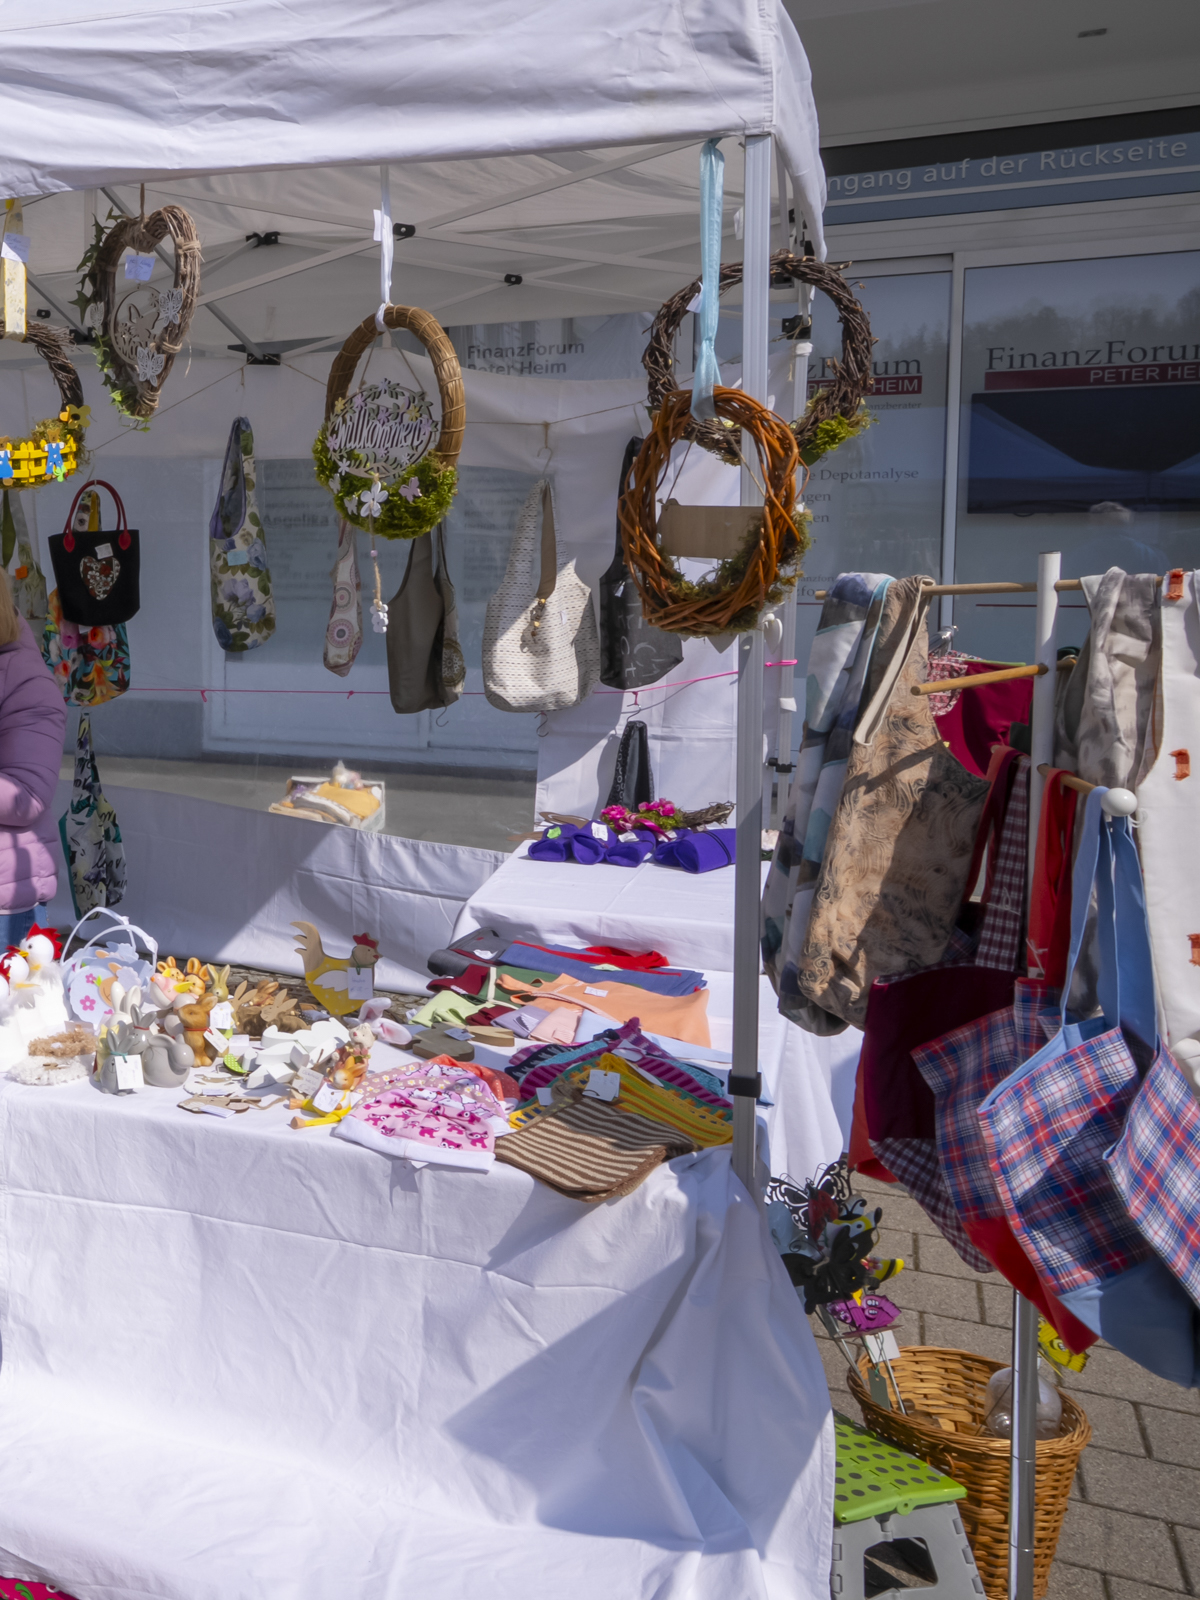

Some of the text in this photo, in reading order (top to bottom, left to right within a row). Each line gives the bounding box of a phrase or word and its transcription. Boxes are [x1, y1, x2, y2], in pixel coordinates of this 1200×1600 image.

[923, 158, 970, 182] auf
[980, 155, 1028, 177] der
[1040, 139, 1189, 171] Rückseite
[467, 342, 585, 360] FinanzForum
[520, 360, 567, 376] Heim
[1089, 367, 1160, 383] PETER
[820, 468, 919, 484] Depotanalyse
